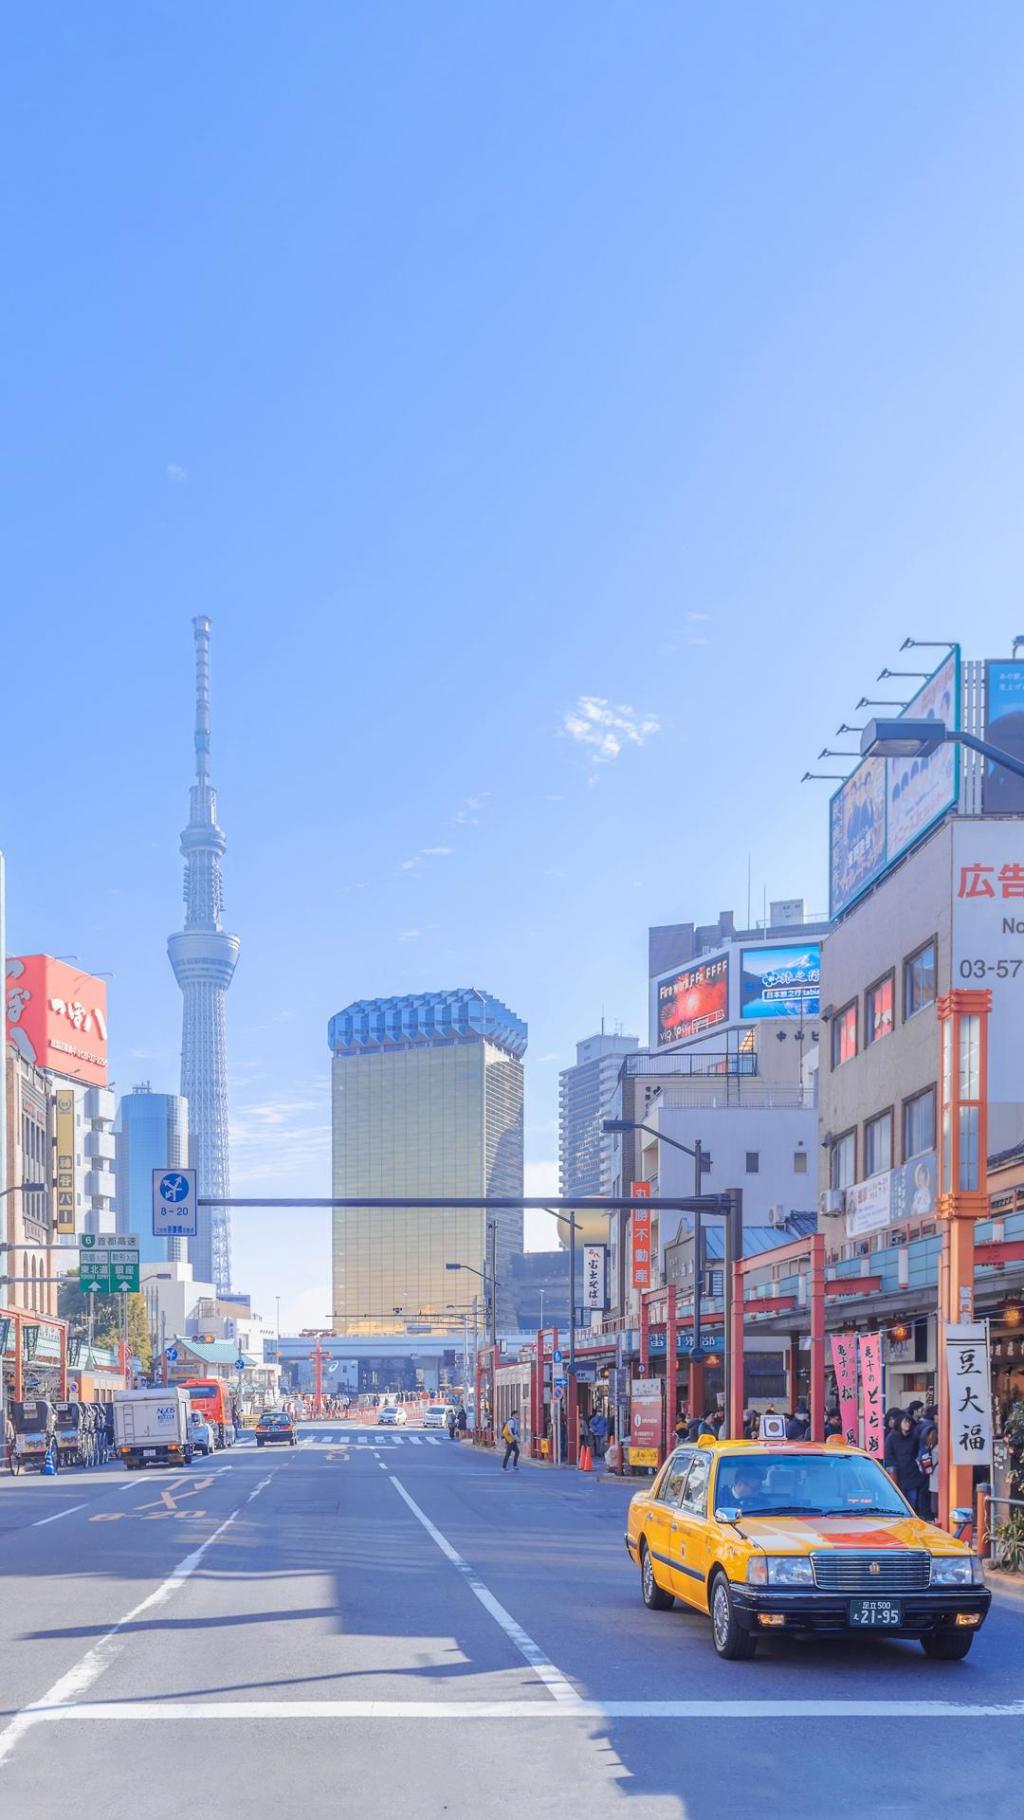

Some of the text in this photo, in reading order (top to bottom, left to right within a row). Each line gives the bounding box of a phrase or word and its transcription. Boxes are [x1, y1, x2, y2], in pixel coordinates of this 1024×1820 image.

[956, 1348, 986, 1451] 豆大福
[862, 1601, 891, 1610] 足立 500
[860, 1609, 899, 1624] 21-95
